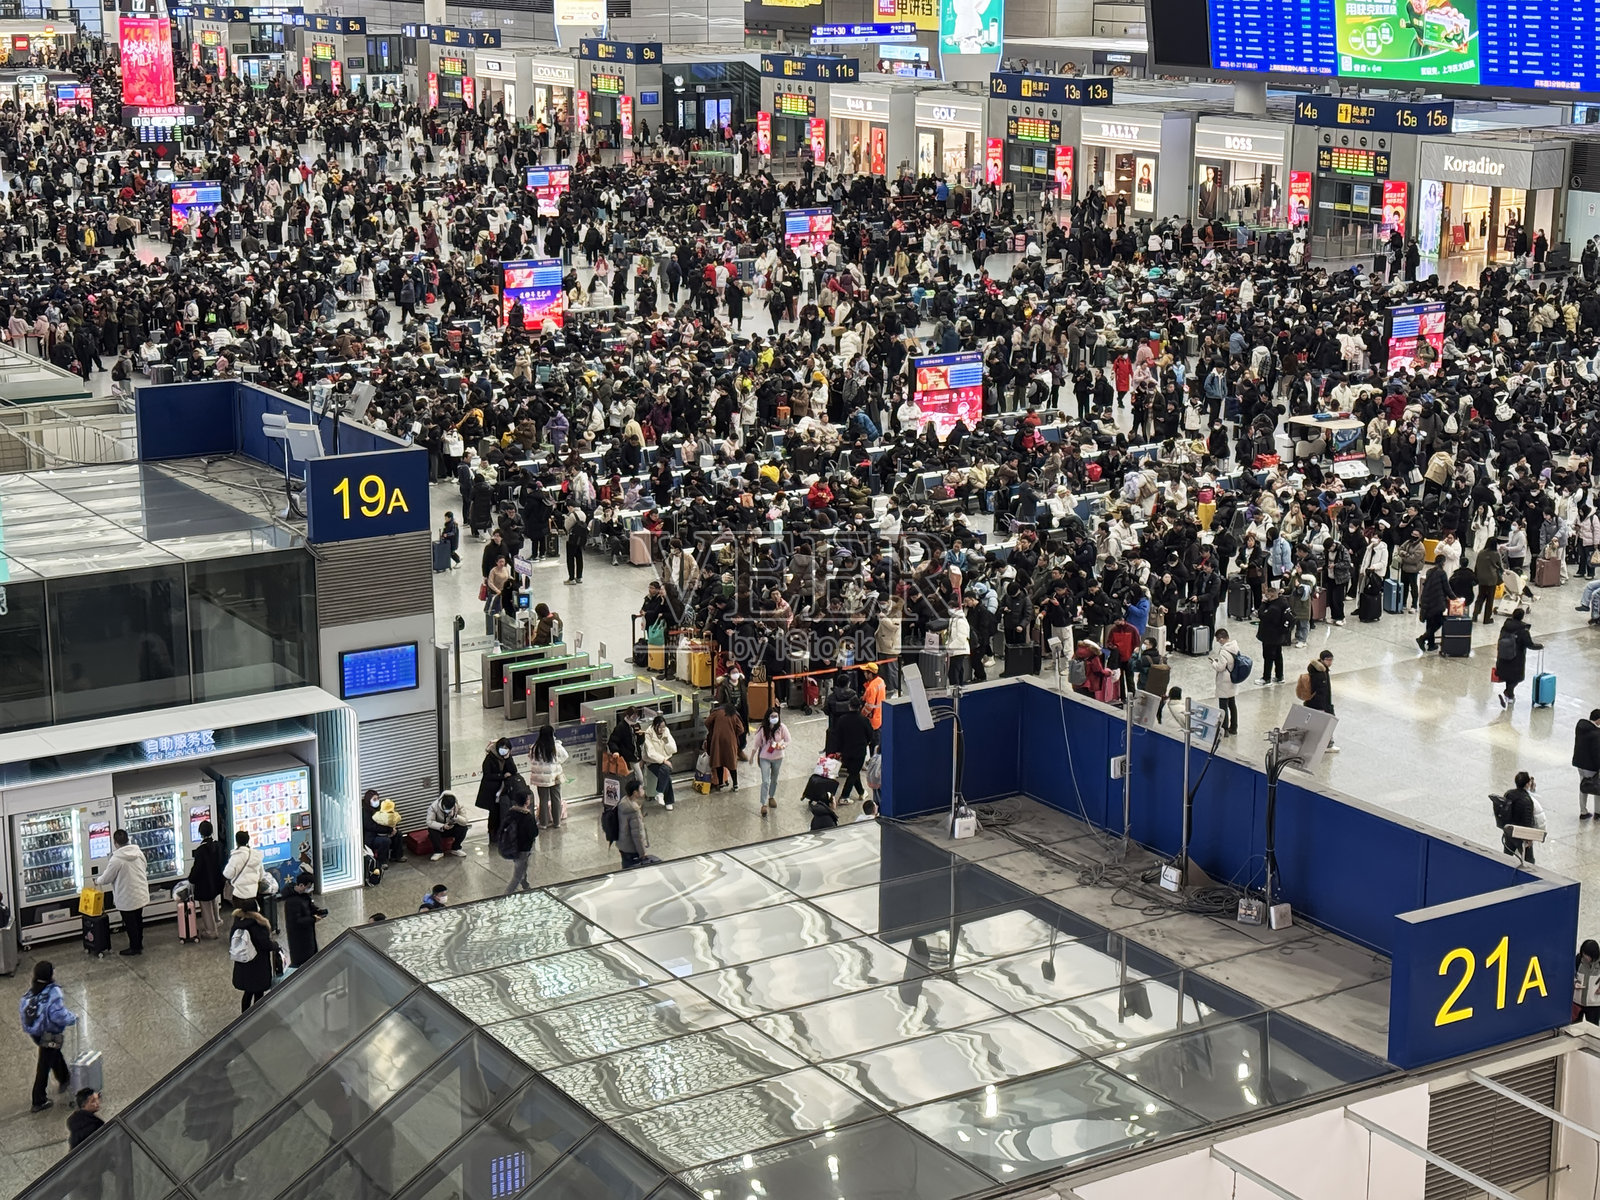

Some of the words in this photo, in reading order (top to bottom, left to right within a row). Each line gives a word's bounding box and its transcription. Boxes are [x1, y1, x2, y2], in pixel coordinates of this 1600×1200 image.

[234, 10, 244, 19] 3B
[349, 20, 360, 30] 5B
[482, 33, 495, 44] 7B
[643, 48, 656, 60] 9B
[762, 59, 774, 72] 10B
[817, 64, 829, 77] 11B
[836, 64, 854, 77] 11B
[538, 67, 569, 79] COACH
[991, 79, 1007, 93] 12B
[1064, 84, 1080, 99] 13B
[1088, 85, 1108, 99] 13B
[1298, 102, 1318, 119] 14B
[1353, 106, 1375, 117] 检票口
[1396, 109, 1417, 127] 15B
[1427, 110, 1448, 127] 15B
[1101, 124, 1139, 140] BALLY
[1225, 136, 1252, 150] BOSS
[1444, 155, 1505, 175] Koradior
[333, 474, 409, 520] 19A
[146, 730, 215, 754] 自助服务区
[1434, 936, 1548, 1027] 21A
